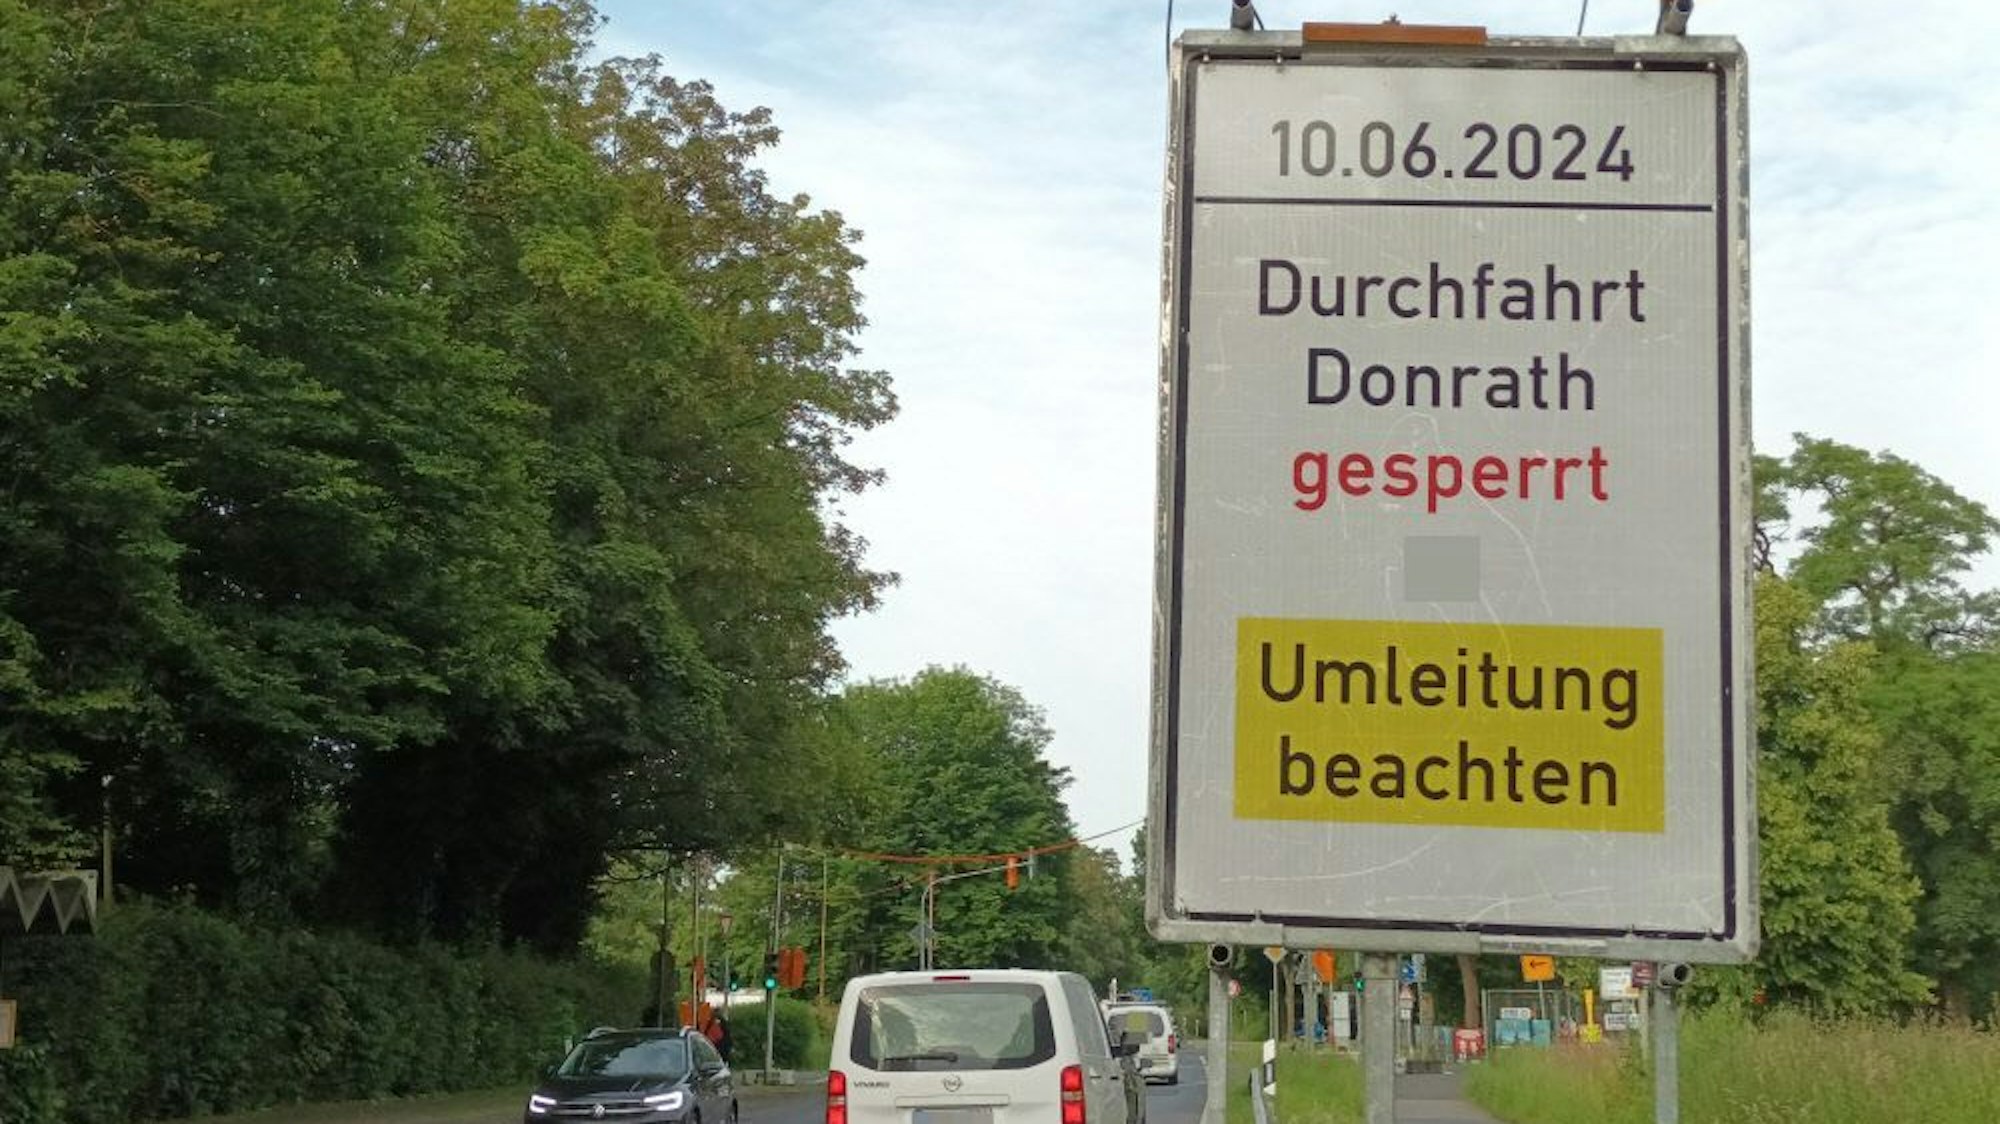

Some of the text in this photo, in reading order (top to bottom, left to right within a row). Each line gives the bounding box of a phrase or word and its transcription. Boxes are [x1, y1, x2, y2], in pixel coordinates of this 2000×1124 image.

[1271, 120, 1635, 181] 10.06.2024
[1258, 259, 1646, 322] Durchfahrt
[1307, 347, 1596, 411] Donrath
[1292, 446, 1609, 513] gesperrt
[1261, 642, 1639, 730] Umleitung
[1280, 736, 1617, 806] beachten
